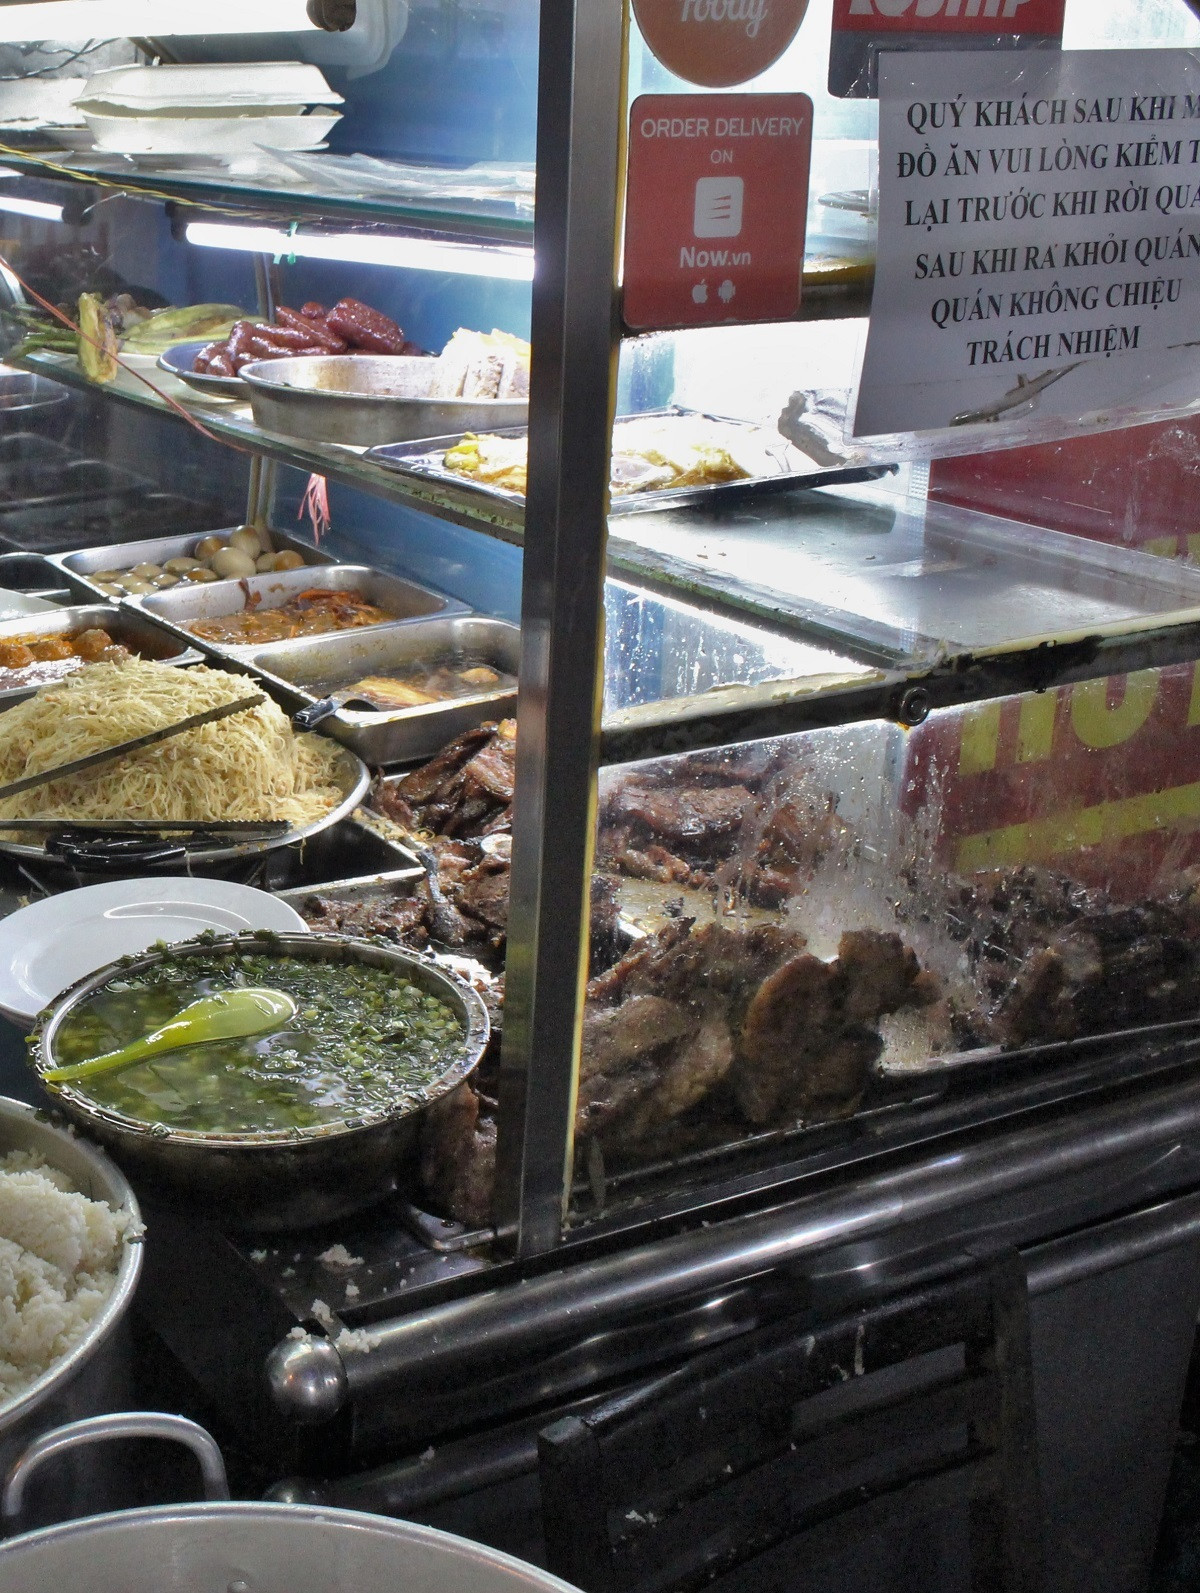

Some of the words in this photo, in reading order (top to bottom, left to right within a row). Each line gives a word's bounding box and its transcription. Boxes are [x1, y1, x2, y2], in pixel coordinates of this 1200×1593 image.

[641, 118, 710, 138] ORDER
[715, 117, 803, 137] DELIVERY
[907, 93, 966, 135] QUÝ
[974, 92, 1068, 127] KHÁCH
[1073, 97, 1122, 123] SAU
[1128, 95, 1177, 121] KHI
[710, 150, 733, 164] ON
[897, 143, 937, 178] ĐỒ
[944, 142, 981, 176] ĂN
[989, 147, 1031, 174] VUI
[1038, 137, 1108, 172] LÒNG
[1115, 133, 1182, 168] KIỂM
[904, 198, 950, 232] LẠI
[957, 186, 1046, 223] TRƯỚC
[1052, 190, 1098, 217] KHI
[1104, 180, 1149, 213] RỜI
[679, 246, 751, 269] Now.vn
[914, 251, 966, 280] SAU
[970, 247, 1018, 275] KHI
[1063, 232, 1128, 267] KHỎI
[931, 287, 1003, 329] QUÁN
[1009, 280, 1099, 317] KHÔNG
[1105, 276, 1182, 311] CHIỆU
[966, 329, 1051, 366] TRÁCH
[1057, 323, 1141, 358] NHIỆM
